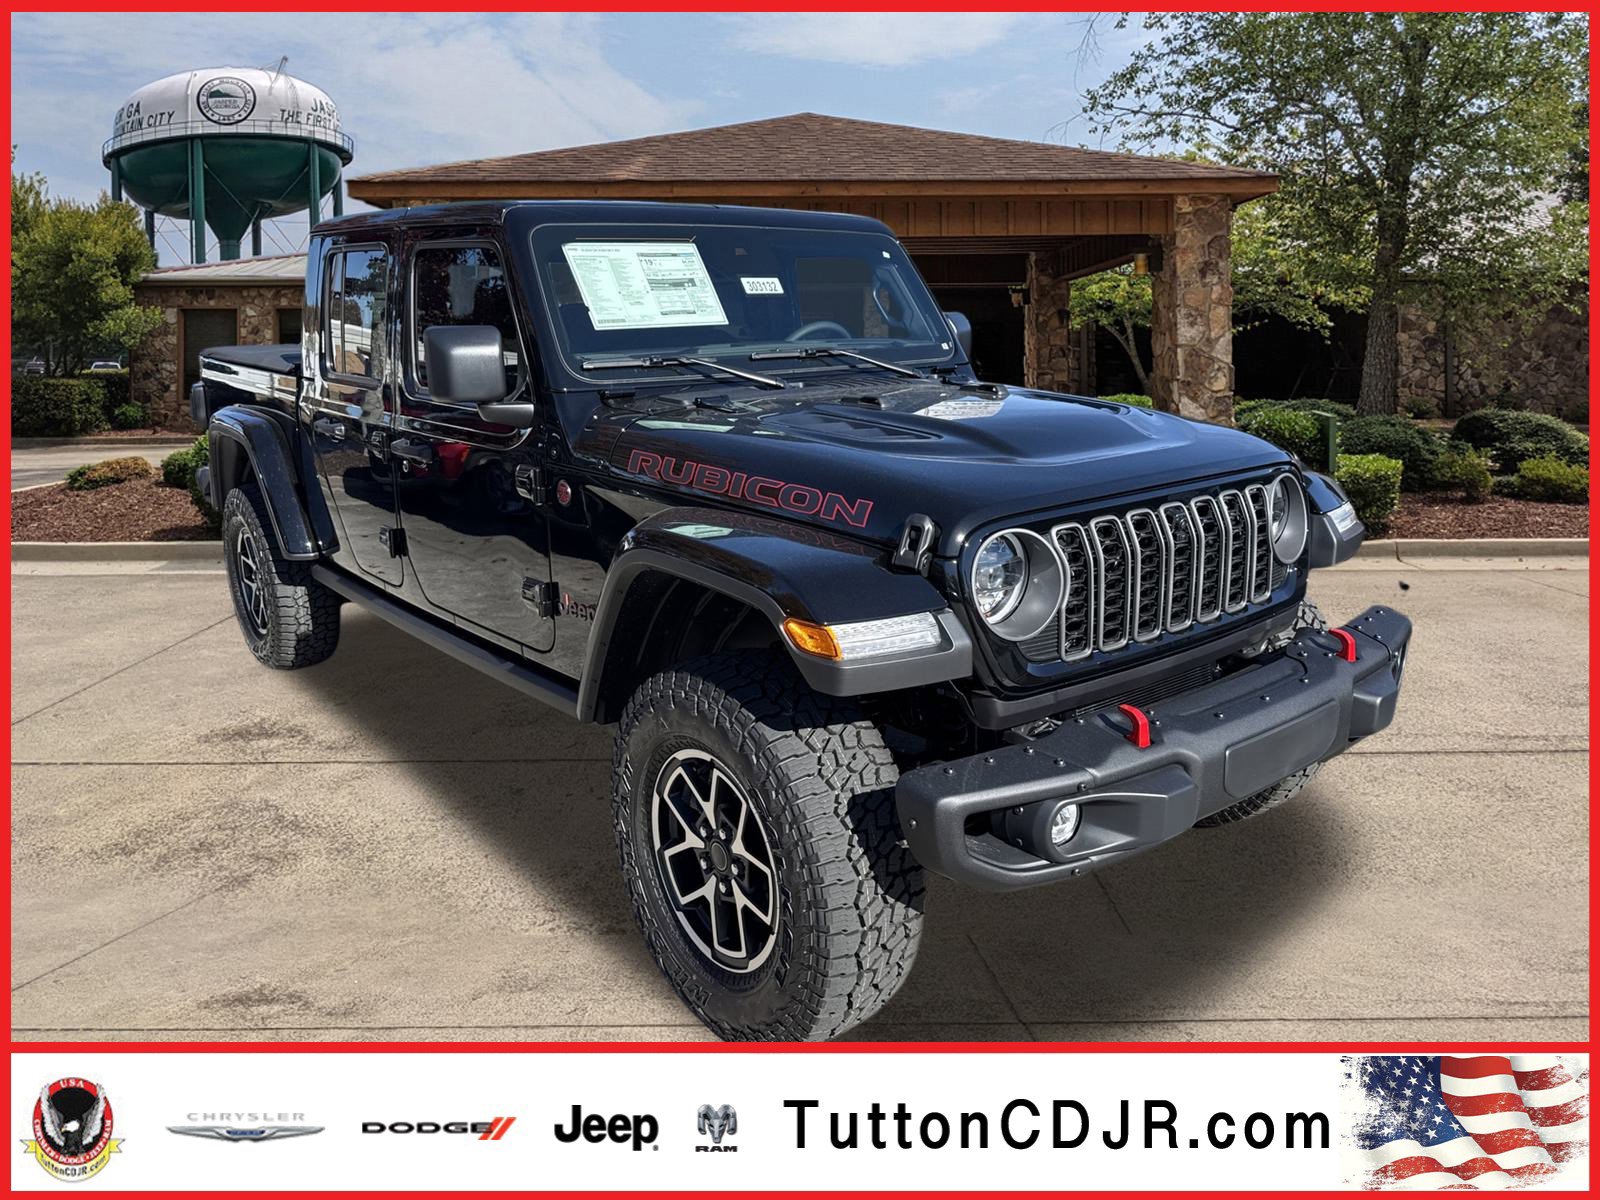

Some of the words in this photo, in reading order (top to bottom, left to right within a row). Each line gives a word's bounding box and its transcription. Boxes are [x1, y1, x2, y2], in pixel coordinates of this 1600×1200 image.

[126, 101, 141, 119] GA
[147, 110, 176, 127] CITY
[280, 108, 302, 124] THE
[306, 112, 332, 129] FIRST
[746, 280, 779, 292] 303132
[627, 448, 874, 528] RUBICON
